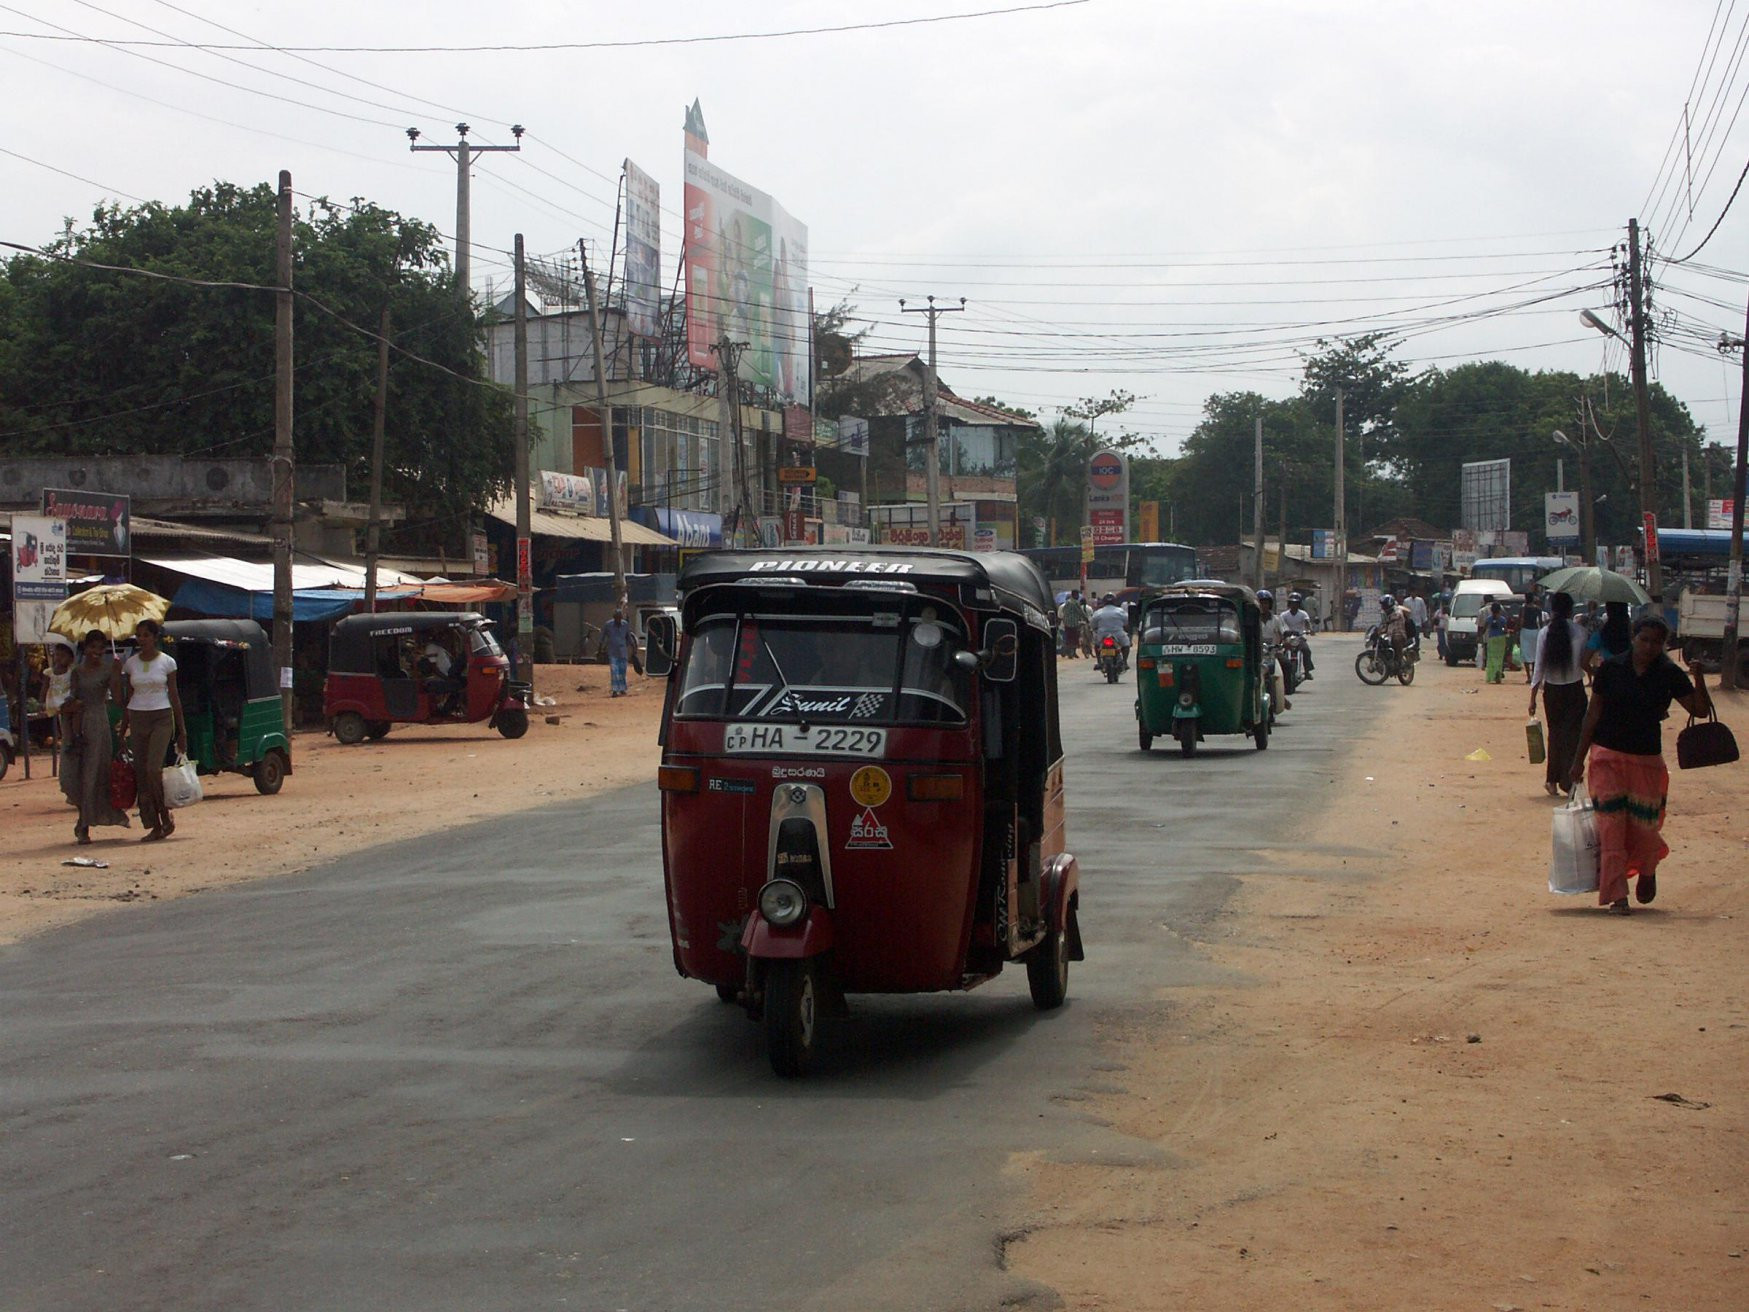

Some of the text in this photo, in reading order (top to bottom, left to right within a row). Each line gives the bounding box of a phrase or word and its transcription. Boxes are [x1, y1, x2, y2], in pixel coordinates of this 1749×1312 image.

[750, 560, 914, 574] PIONEER
[370, 626, 412, 637] FREEDOM
[770, 693, 851, 715] Sunil
[815, 729, 882, 753] 2229
[709, 779, 722, 790] RE
